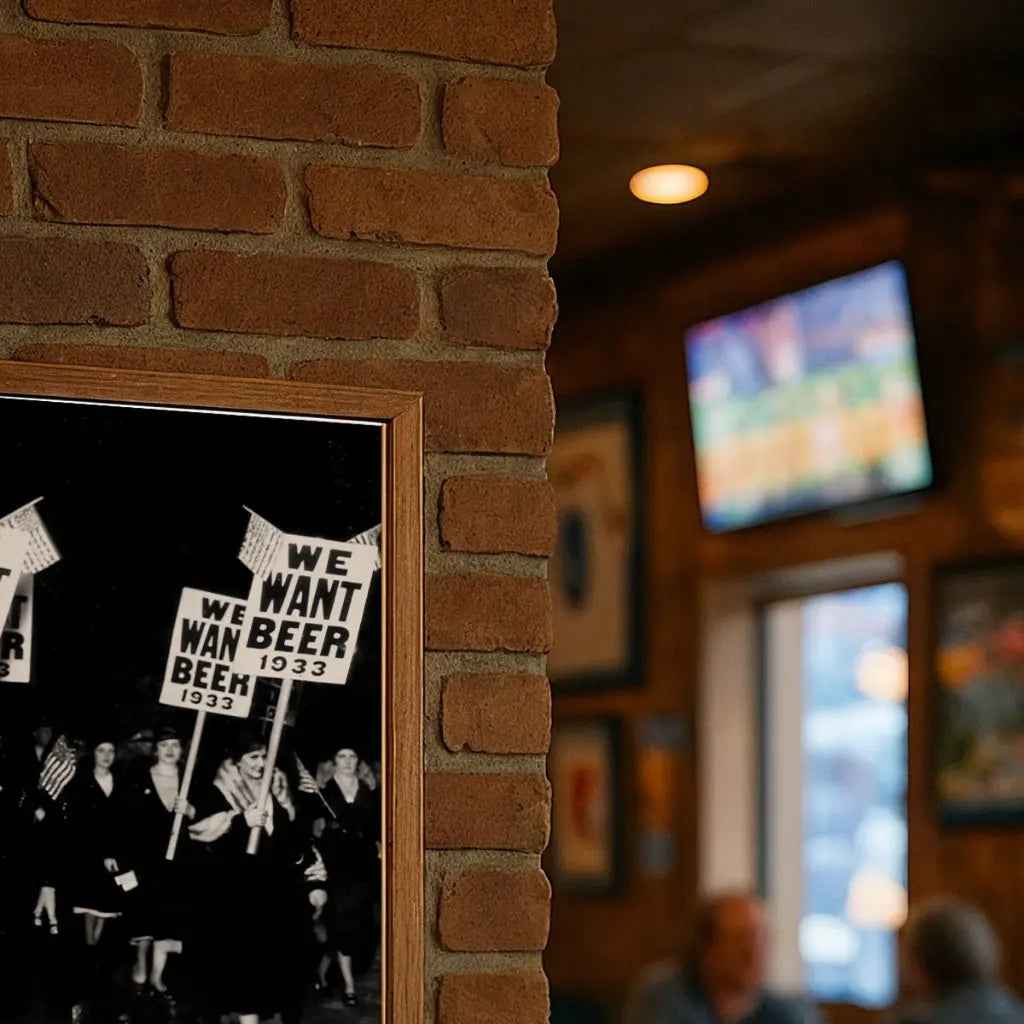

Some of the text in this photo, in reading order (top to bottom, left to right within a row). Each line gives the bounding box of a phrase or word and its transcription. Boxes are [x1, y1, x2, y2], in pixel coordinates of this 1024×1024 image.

[288, 543, 352, 576] WE
[201, 597, 246, 626] WE
[260, 571, 362, 622] WANT
[180, 618, 241, 662] WAN
[246, 616, 350, 659] BEER
[171, 655, 251, 697] BEER
[260, 654, 326, 677] 1933
[181, 688, 234, 711] 1933
